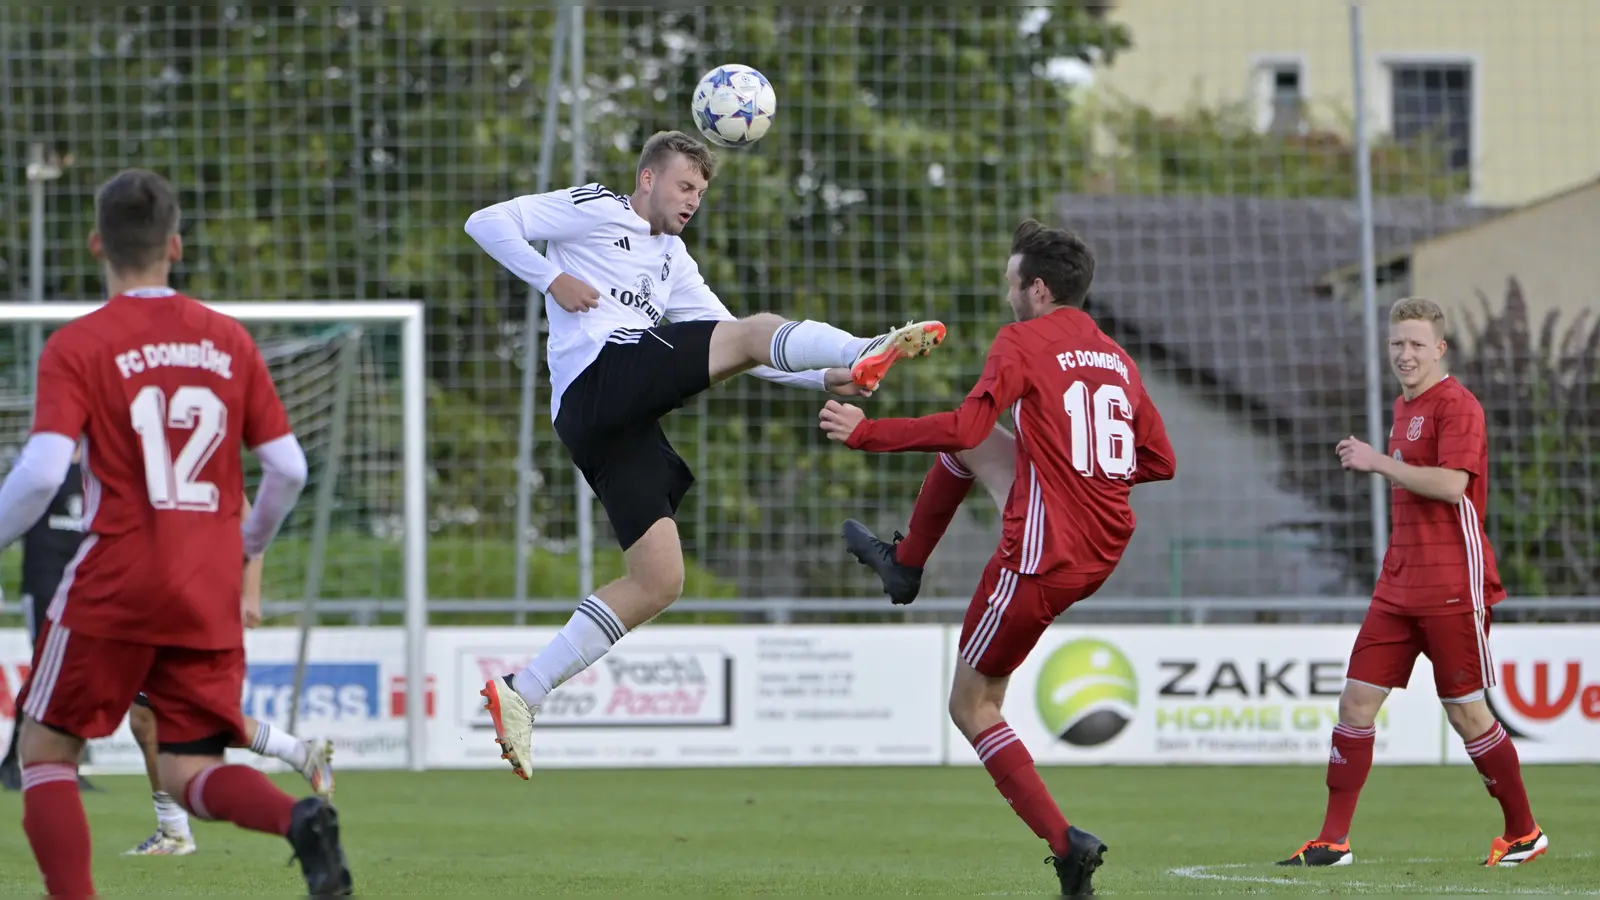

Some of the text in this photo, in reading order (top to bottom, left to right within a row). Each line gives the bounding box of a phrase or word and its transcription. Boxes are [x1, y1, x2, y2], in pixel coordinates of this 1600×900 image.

[115, 338, 233, 380] FC DOMBÜHL
[1056, 350, 1130, 385] FC DOMBÜHL
[130, 385, 227, 512] 12
[1063, 380, 1137, 480] 16
[1156, 706, 1281, 731] HOME
